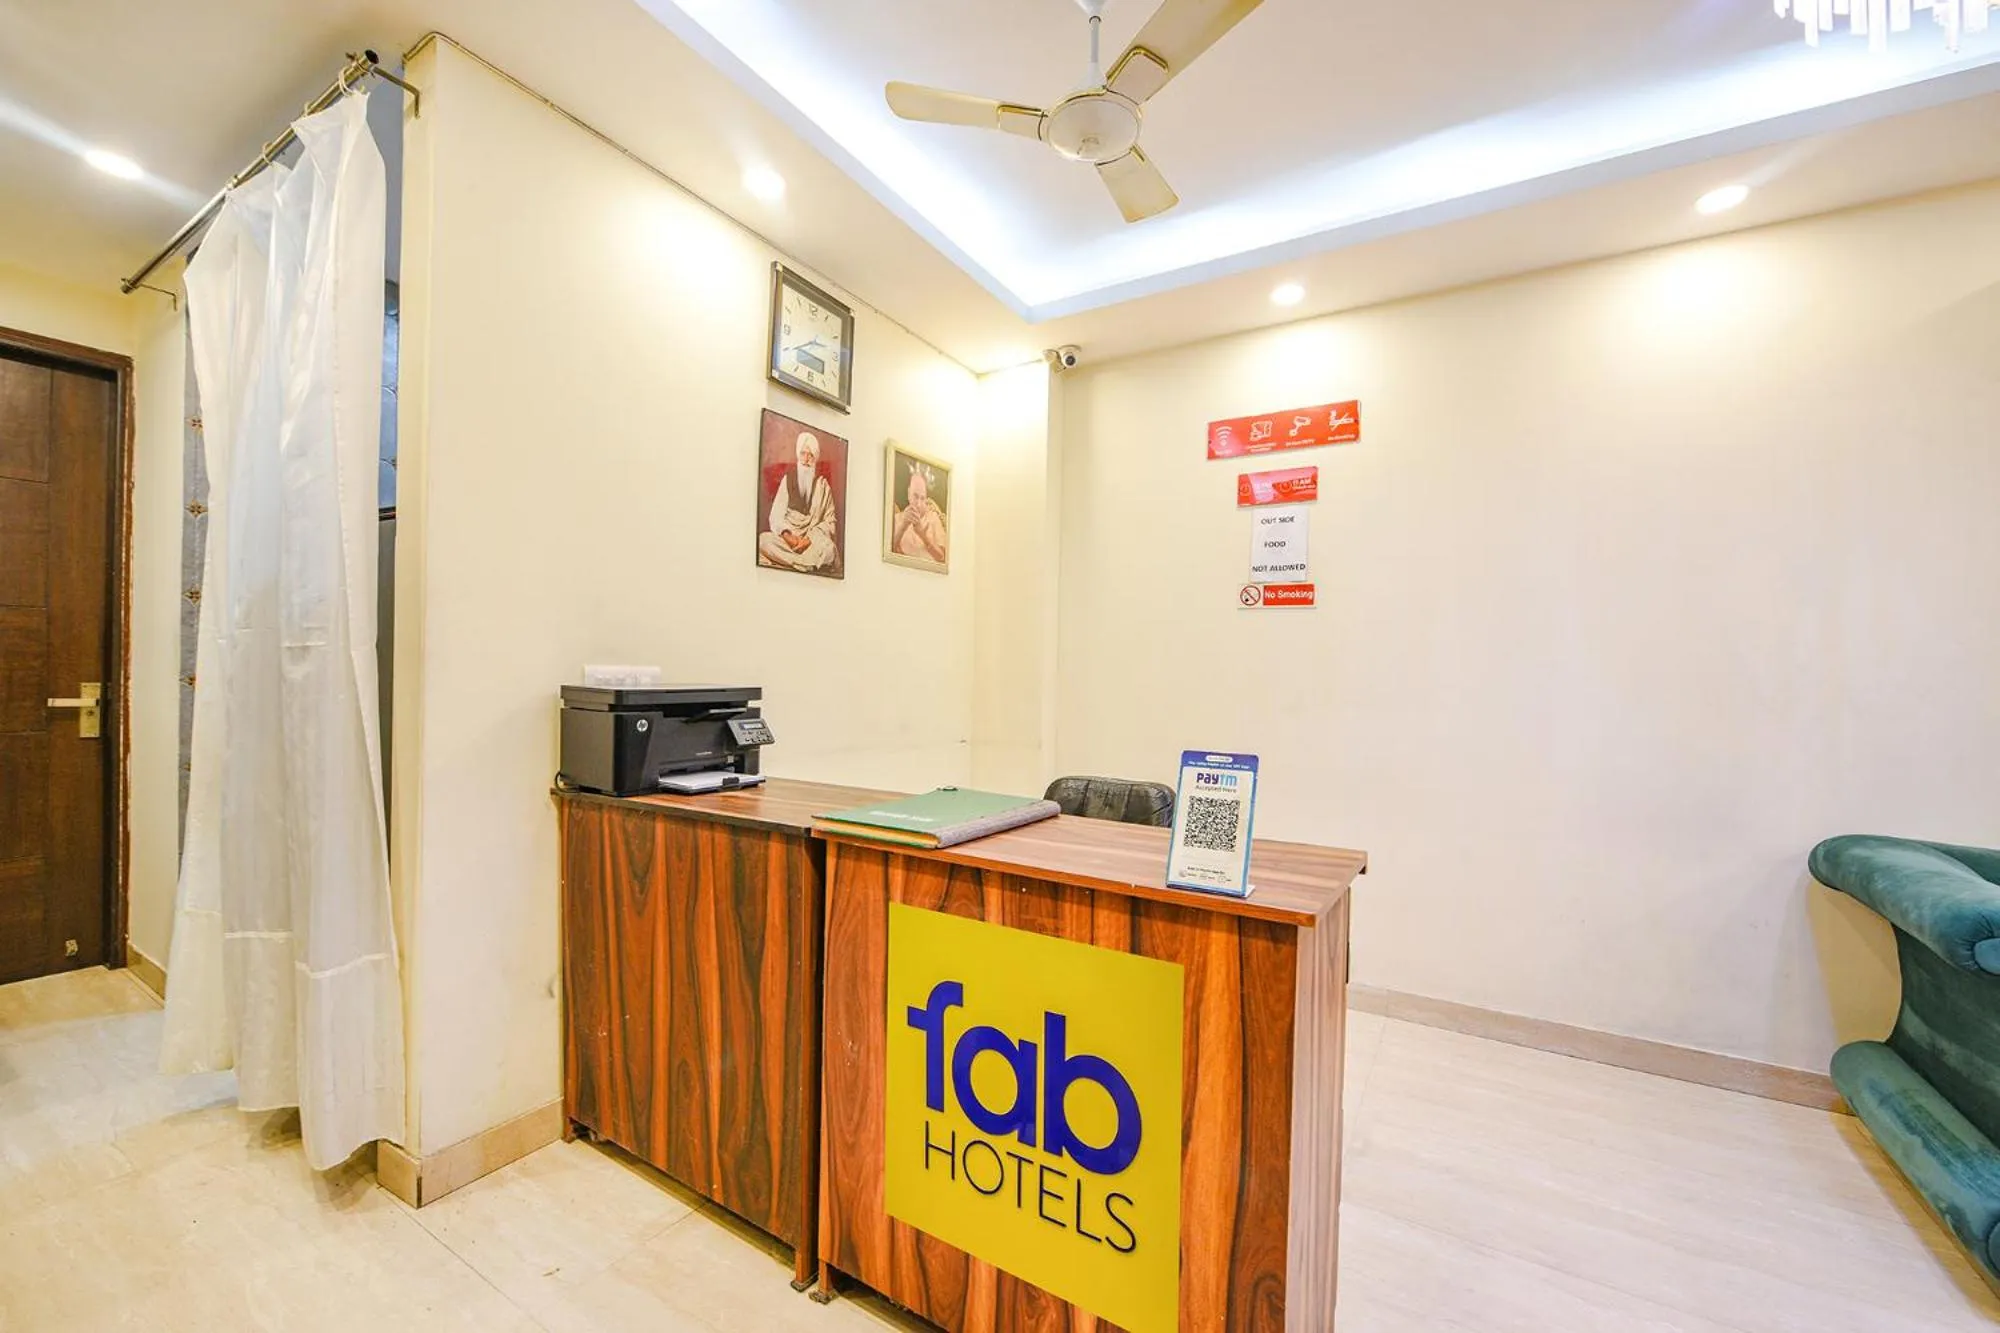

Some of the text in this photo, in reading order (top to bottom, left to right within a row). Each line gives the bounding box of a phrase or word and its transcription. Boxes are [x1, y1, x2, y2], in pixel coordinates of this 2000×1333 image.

[1260, 515, 1295, 525] OUT SIDE
[1264, 540, 1286, 548] FOOD
[1252, 563, 1306, 573] NOT ALLOWED
[1264, 589, 1313, 600] No Smoking
[907, 980, 1142, 1176] fab
[924, 1119, 1137, 1254] HOTELS
